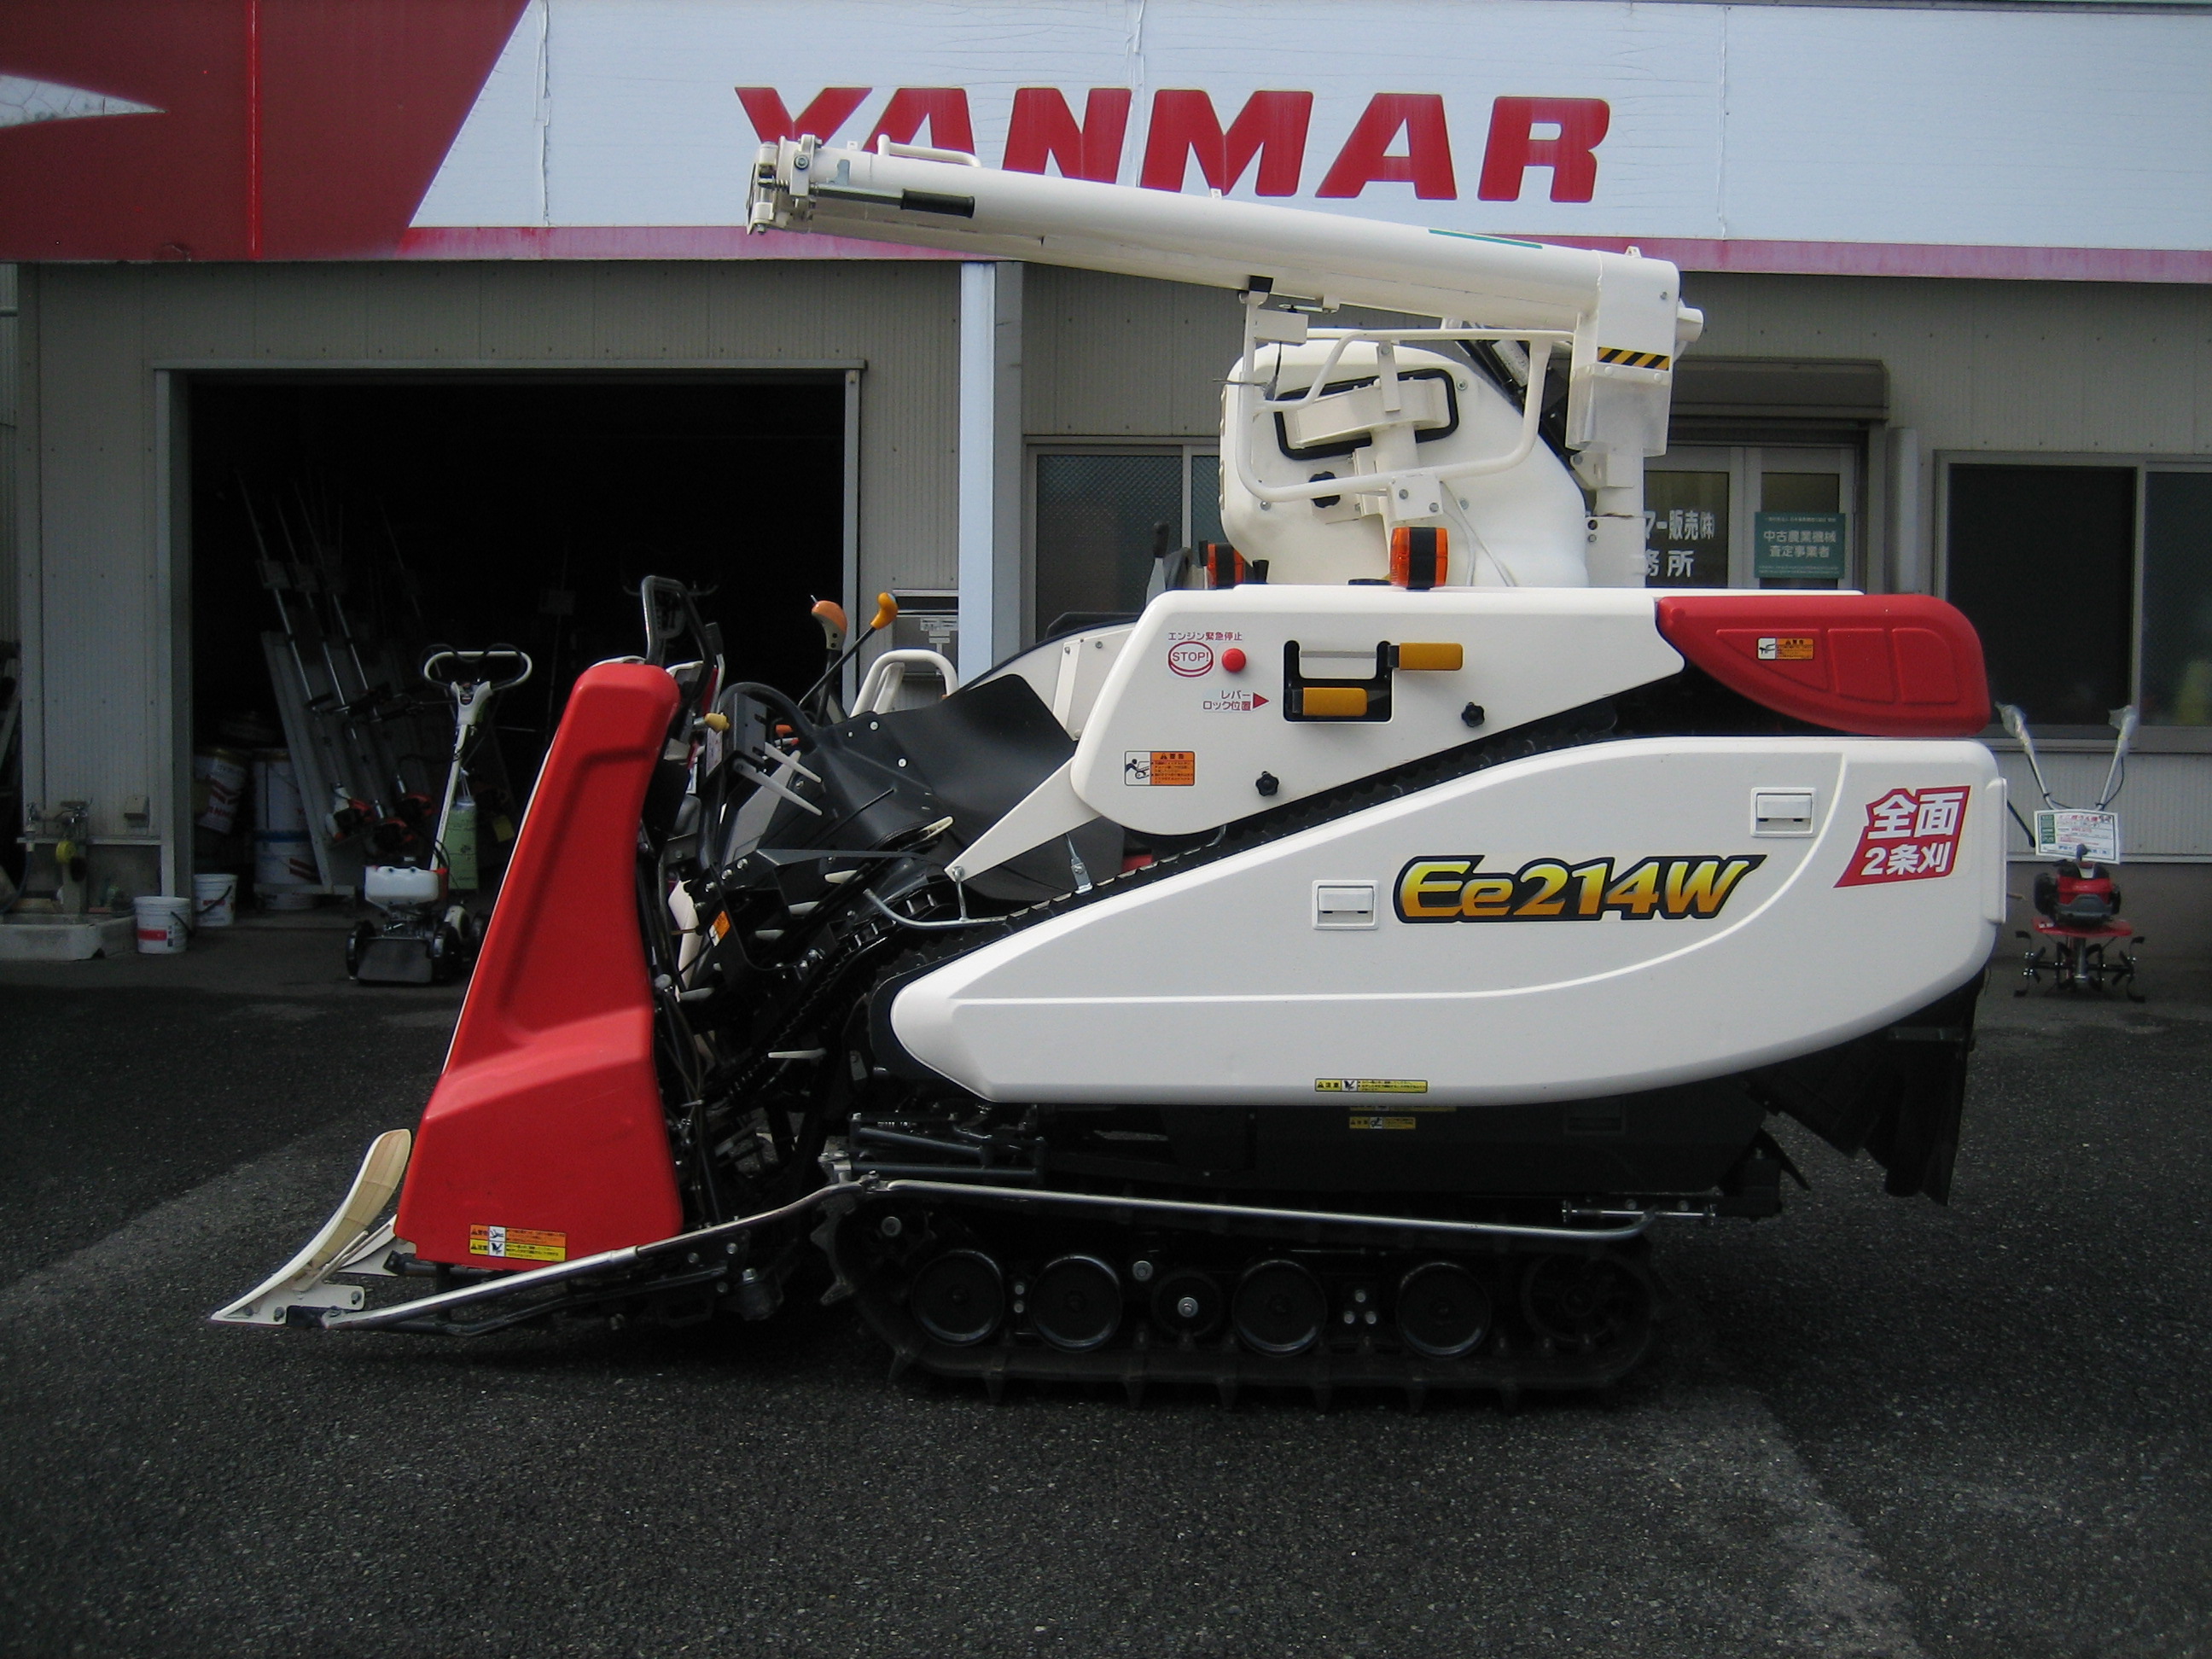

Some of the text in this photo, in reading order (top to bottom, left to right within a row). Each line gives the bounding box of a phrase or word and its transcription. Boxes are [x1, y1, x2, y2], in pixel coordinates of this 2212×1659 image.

[734, 86, 1610, 202] YANMAR
[1168, 632, 1243, 641] エンジン緊急停止
[1172, 652, 1209, 661] STOP!
[1221, 690, 1251, 699] レバー
[1202, 701, 1251, 711] ロック位置
[1867, 792, 1964, 839] 全面
[1860, 841, 1952, 876] 2条刈
[1397, 859, 1753, 919] Ee214W
